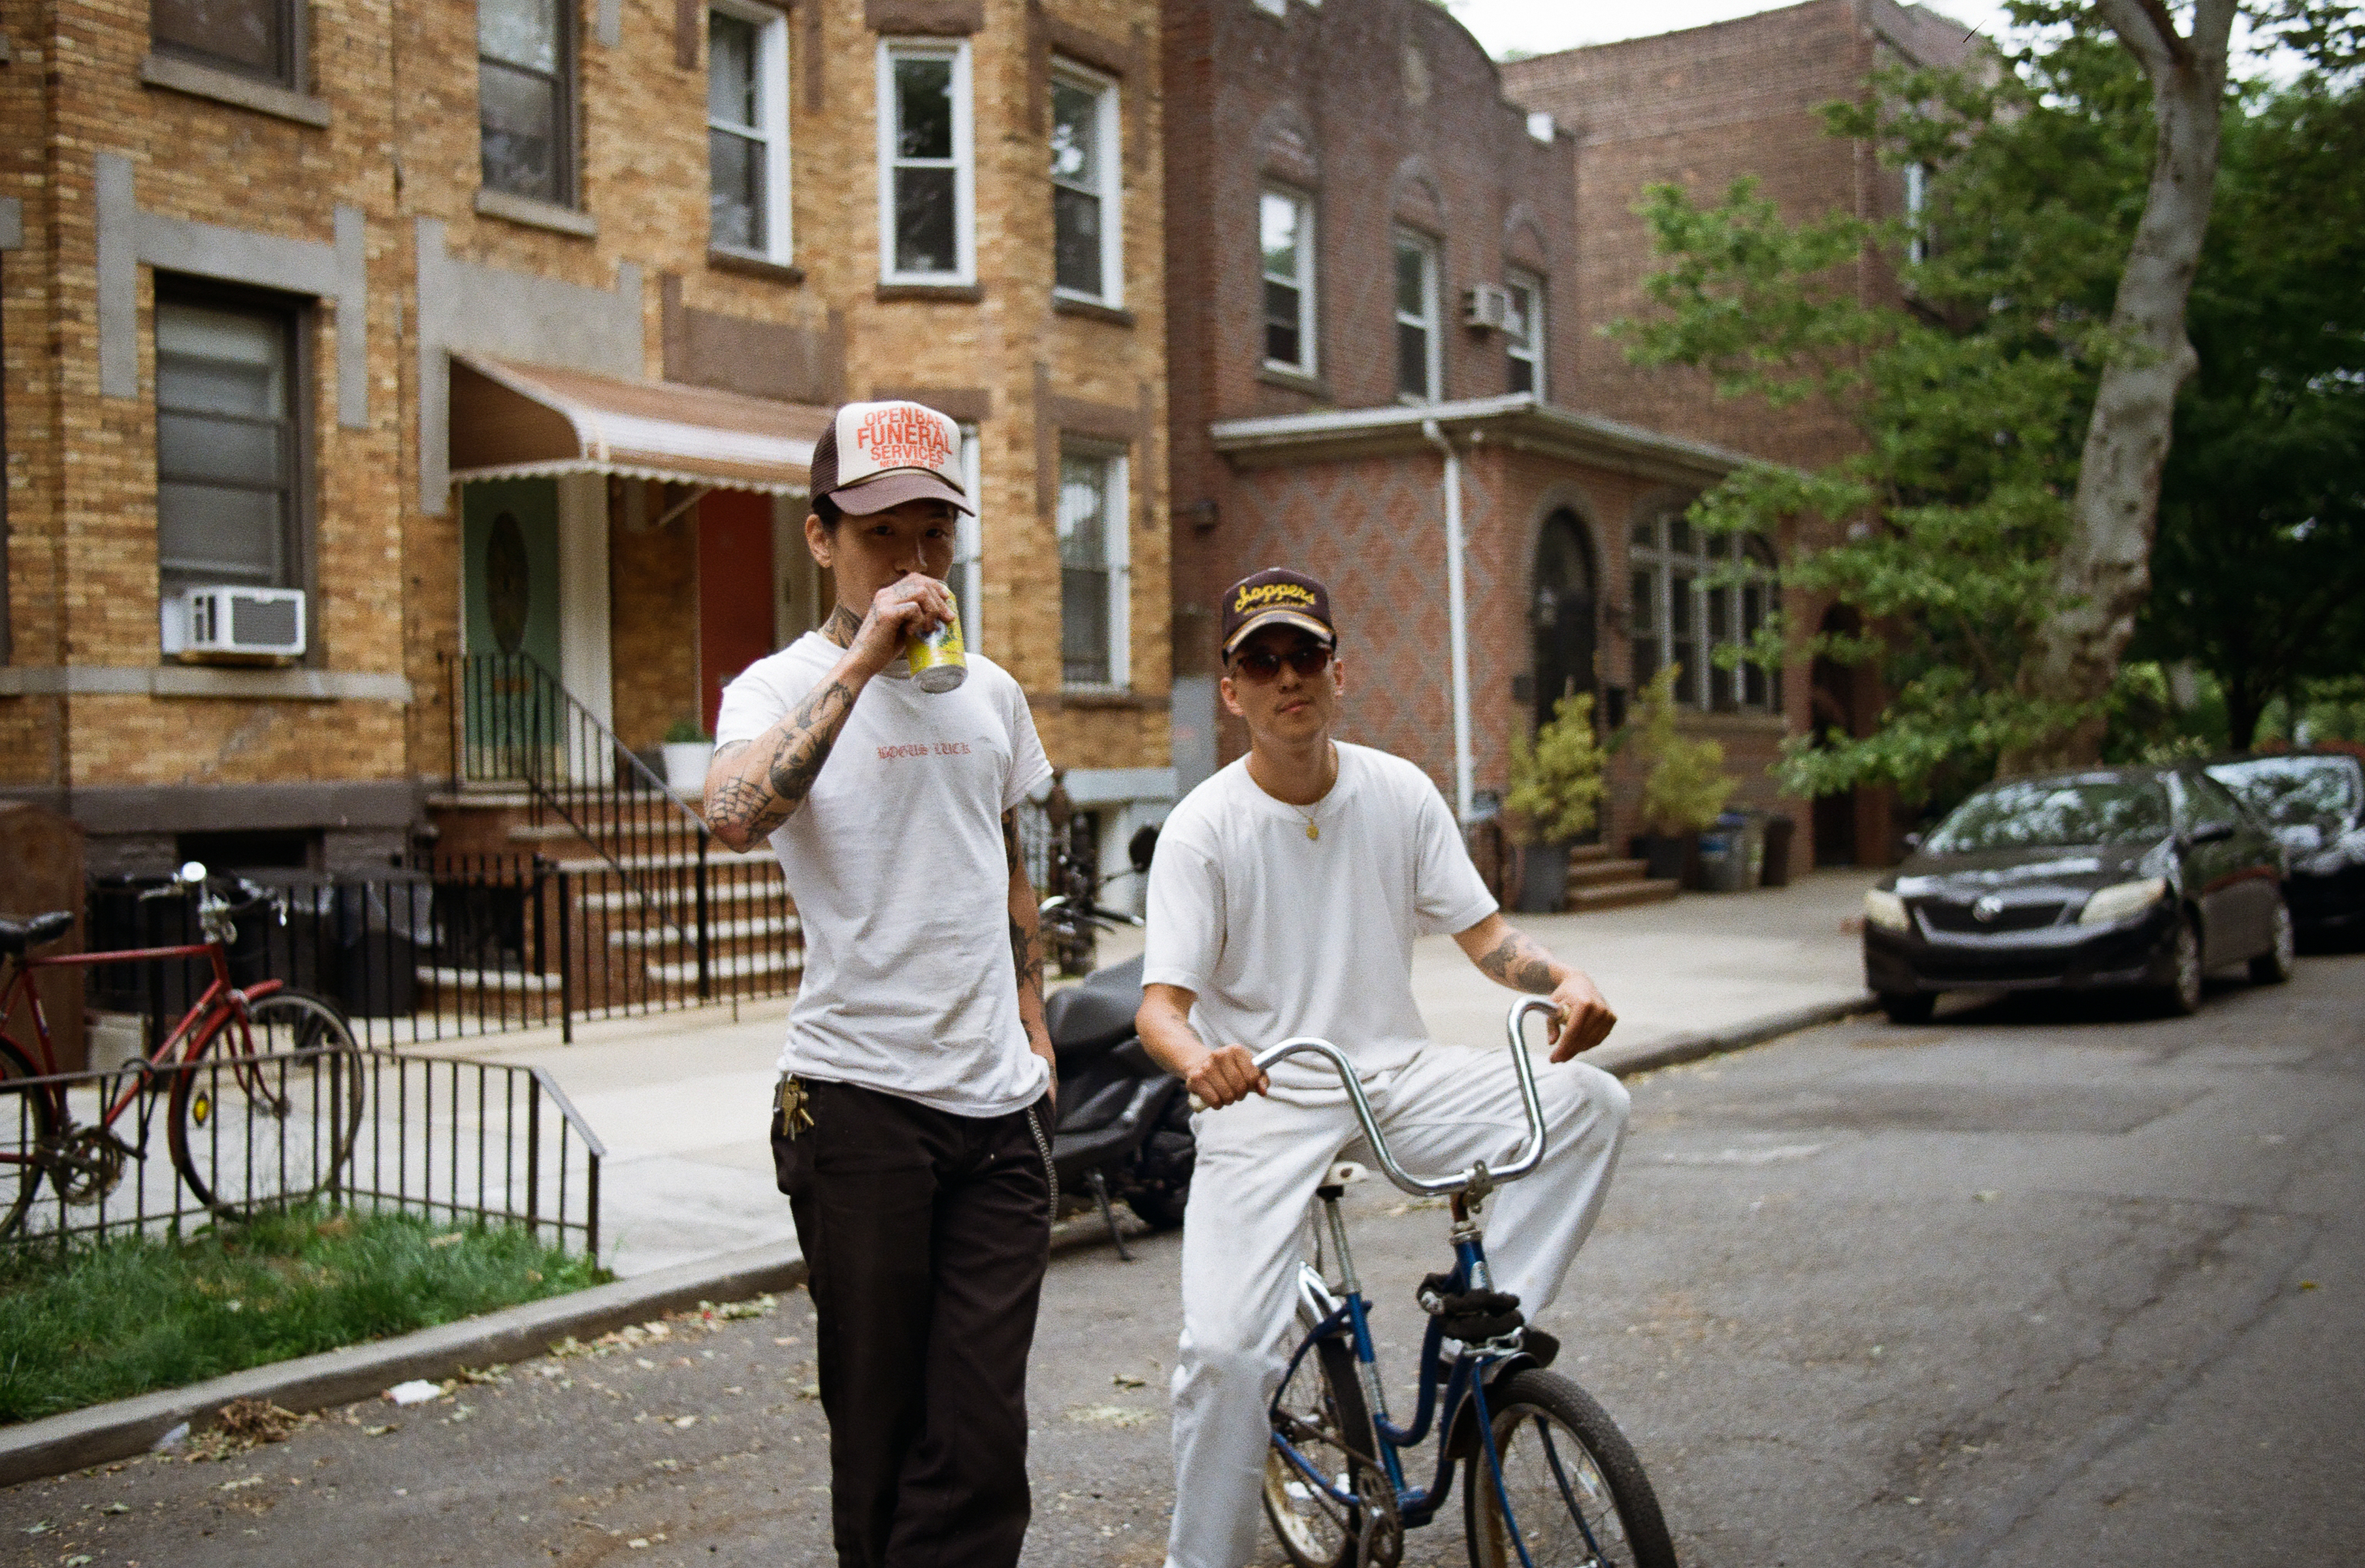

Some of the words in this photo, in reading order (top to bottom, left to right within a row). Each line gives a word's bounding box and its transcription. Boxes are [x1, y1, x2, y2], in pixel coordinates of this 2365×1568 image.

[864, 407, 912, 426] OPEN
[857, 423, 953, 455] FUNERAL
[871, 445, 945, 465] SERVICES
[880, 460, 899, 468] NEW
